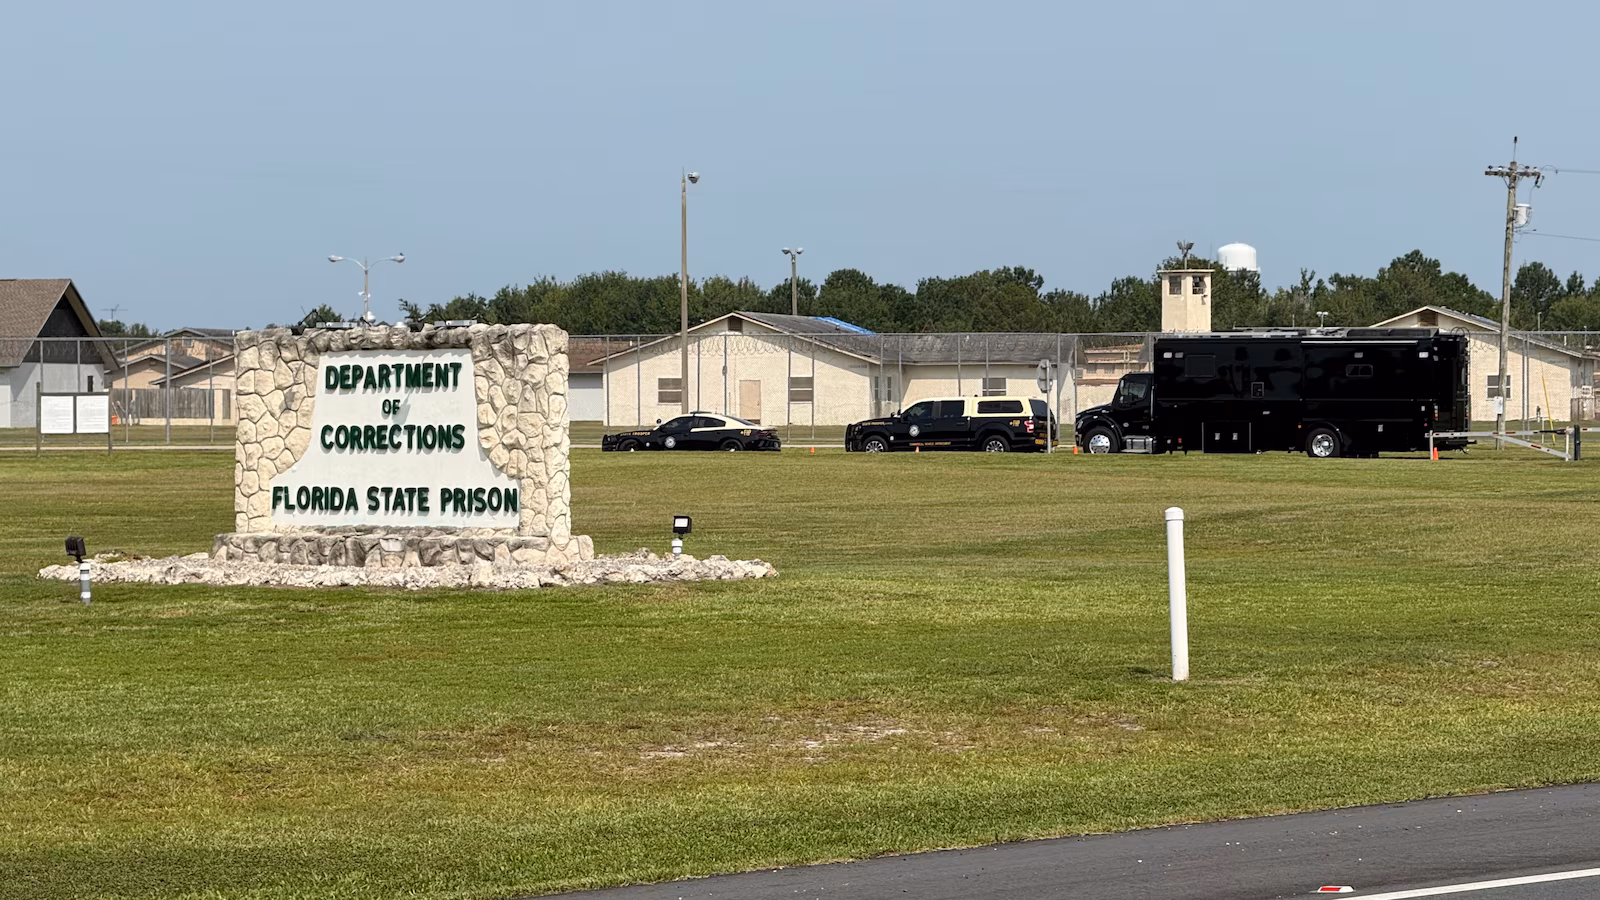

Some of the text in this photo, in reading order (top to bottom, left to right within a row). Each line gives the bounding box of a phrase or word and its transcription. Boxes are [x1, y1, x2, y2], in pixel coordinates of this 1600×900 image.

[325, 362, 462, 390] DEPARTMENT
[382, 399, 401, 416] OF
[320, 424, 466, 451] CORRECTIONS
[271, 486, 519, 513] FLORIDA STATE PRISON
